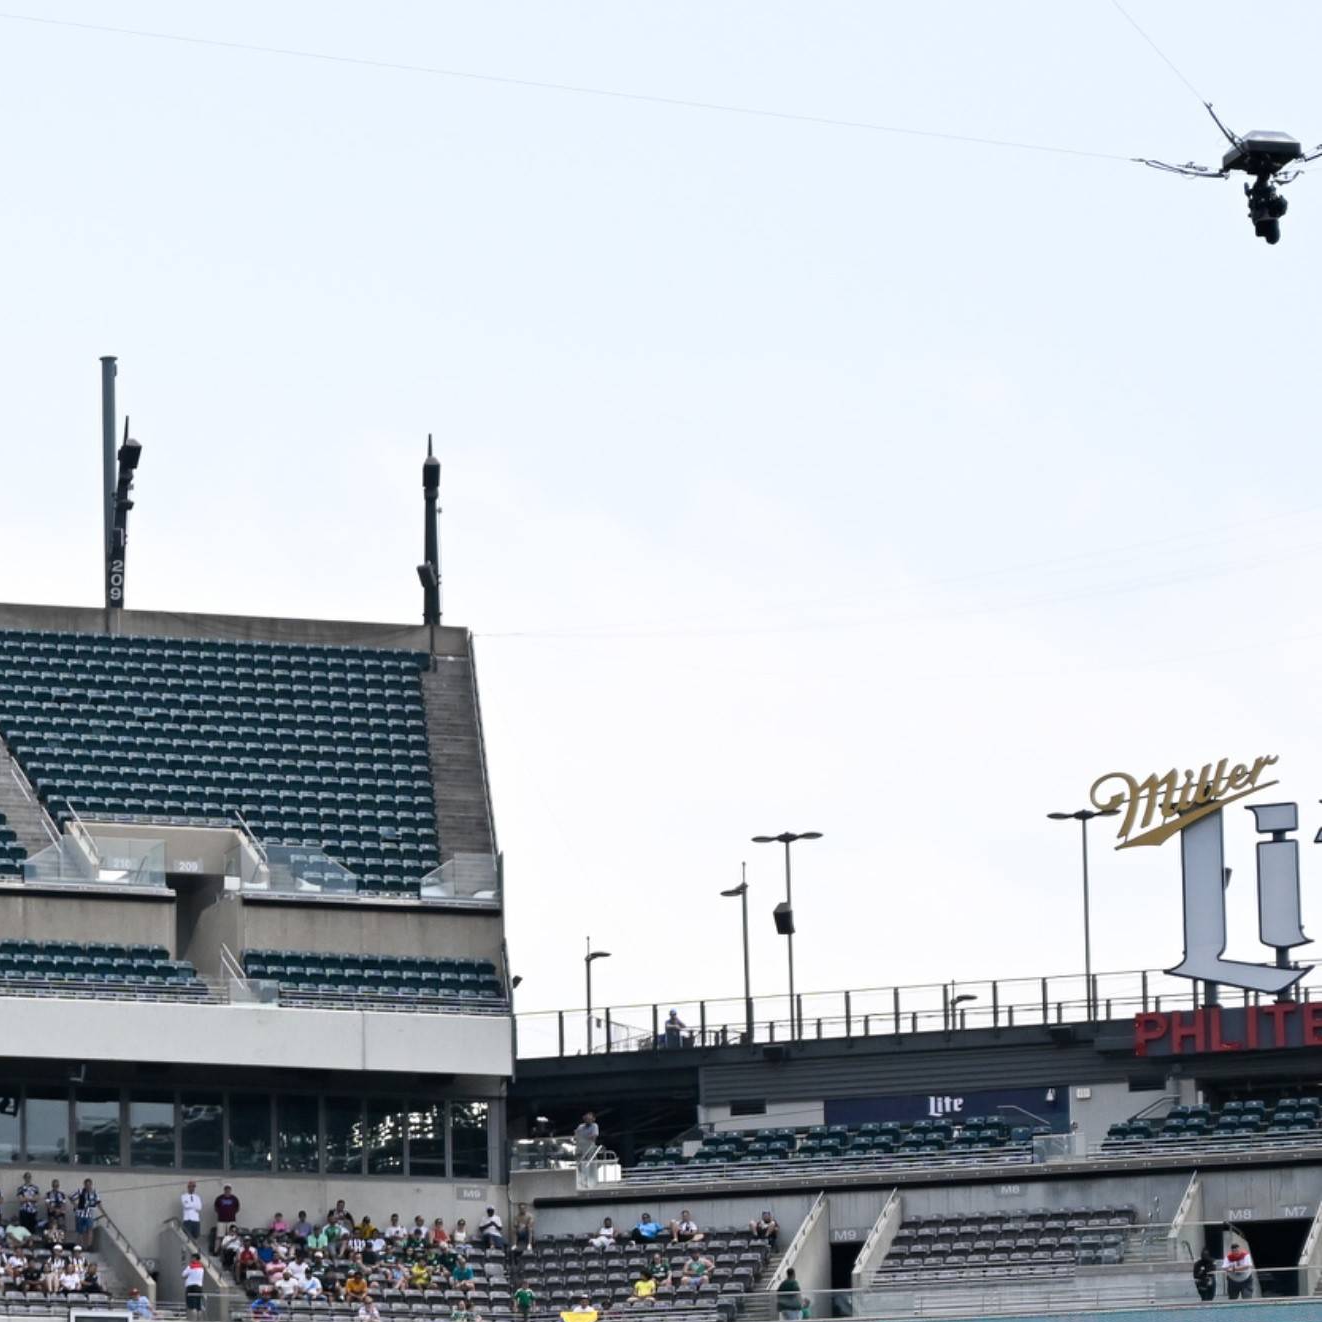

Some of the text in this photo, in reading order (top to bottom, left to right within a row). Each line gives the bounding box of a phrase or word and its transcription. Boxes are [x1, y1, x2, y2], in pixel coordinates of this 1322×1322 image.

[1090, 755, 1279, 842] Miller
[1164, 802, 1322, 995] Li
[927, 1095, 964, 1118] Lite
[1284, 1206, 1307, 1218] M7
[834, 1230, 857, 1241] M9
